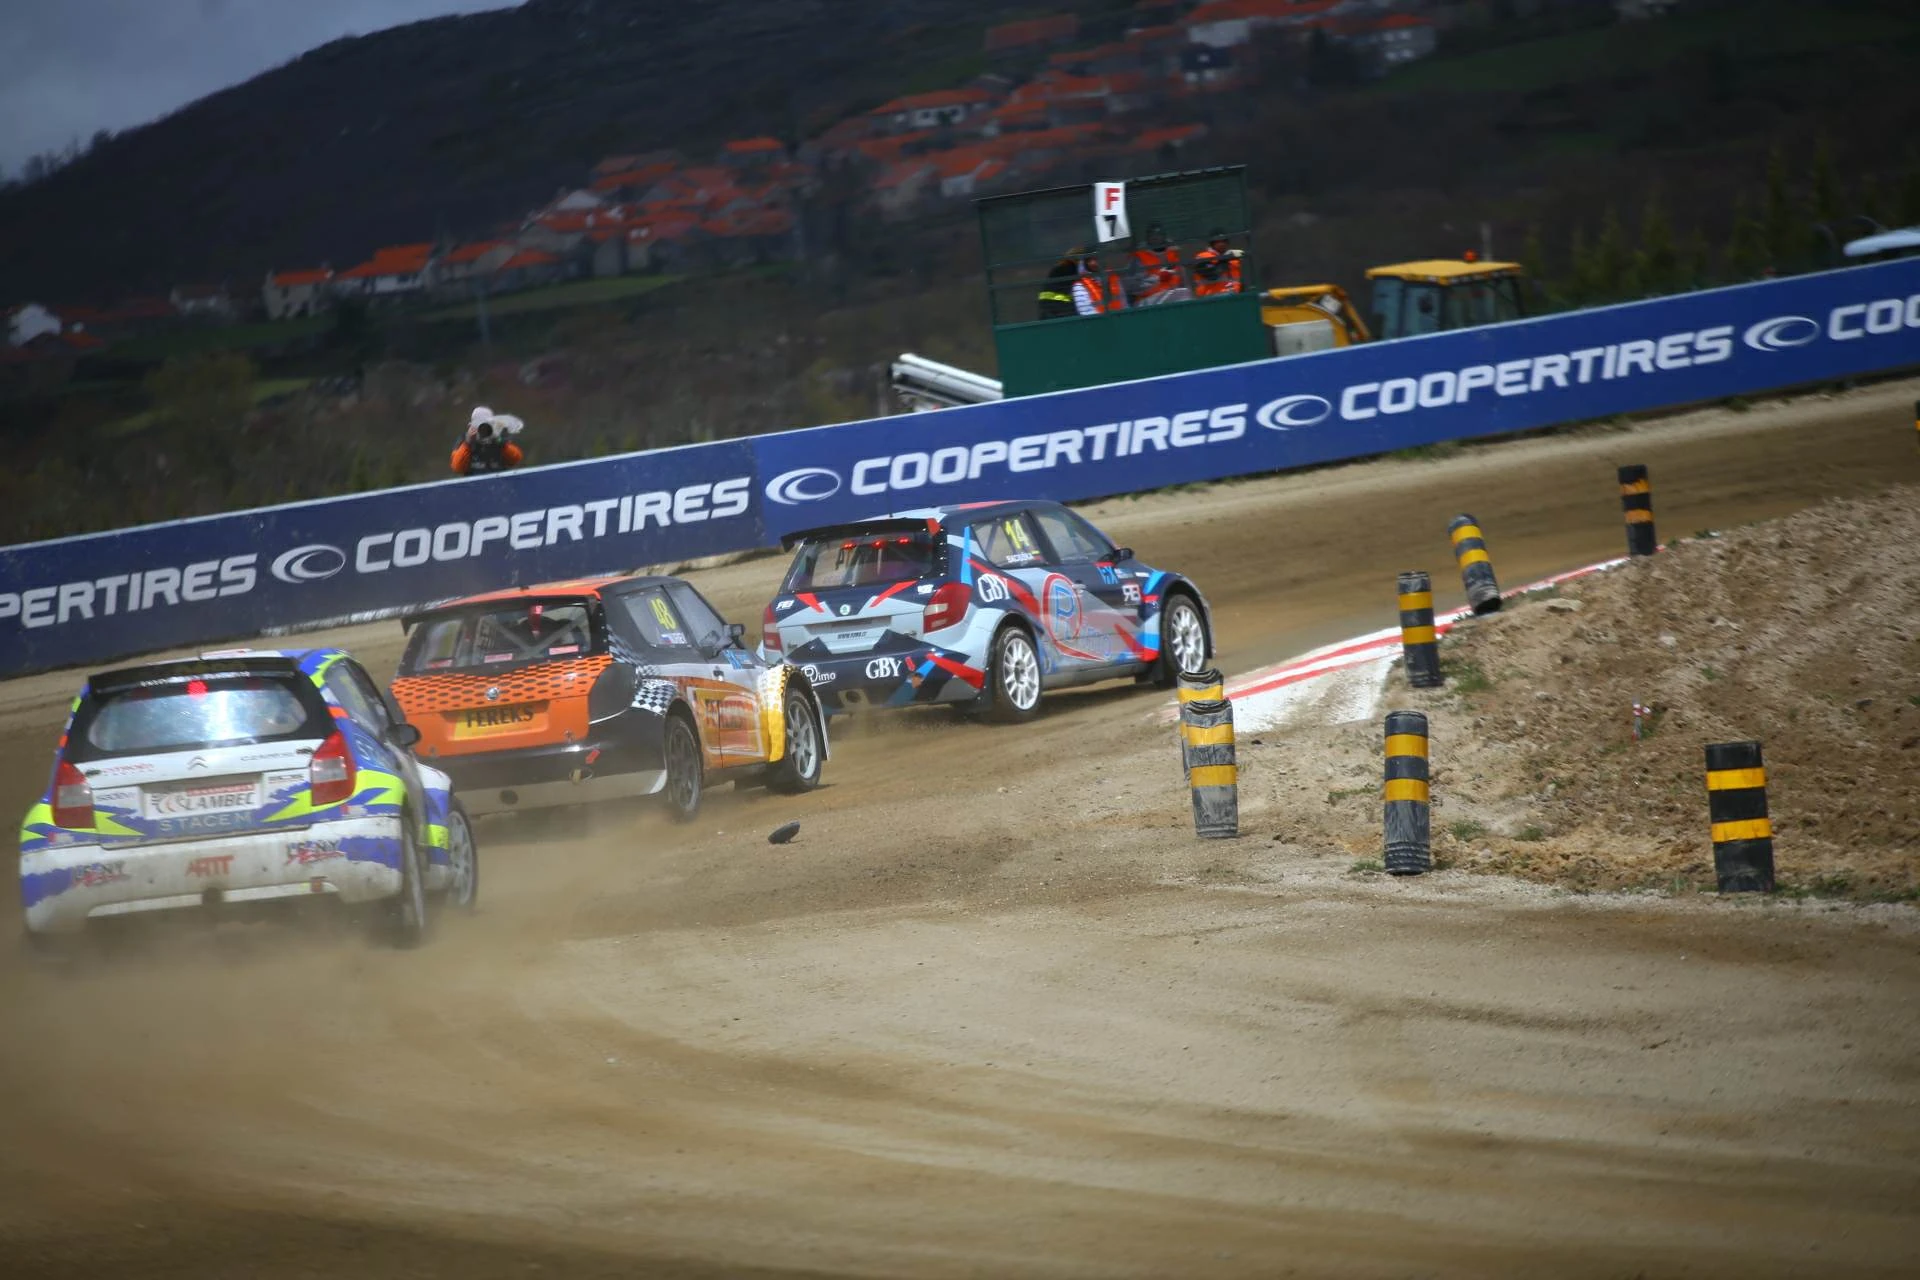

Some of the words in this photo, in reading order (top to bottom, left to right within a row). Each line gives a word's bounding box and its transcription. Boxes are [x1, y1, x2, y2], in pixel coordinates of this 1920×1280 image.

[1104, 187, 1121, 210] F
[1104, 214, 1118, 237] 7
[1340, 326, 1733, 421] COOPERTIRES
[850, 403, 1248, 496] COOPERTIRES
[355, 476, 751, 574] COOPERTIRES
[1005, 519, 1030, 550] 14
[978, 573, 1011, 603] GBY
[865, 657, 902, 680] GBY
[466, 705, 534, 728] FEREKS
